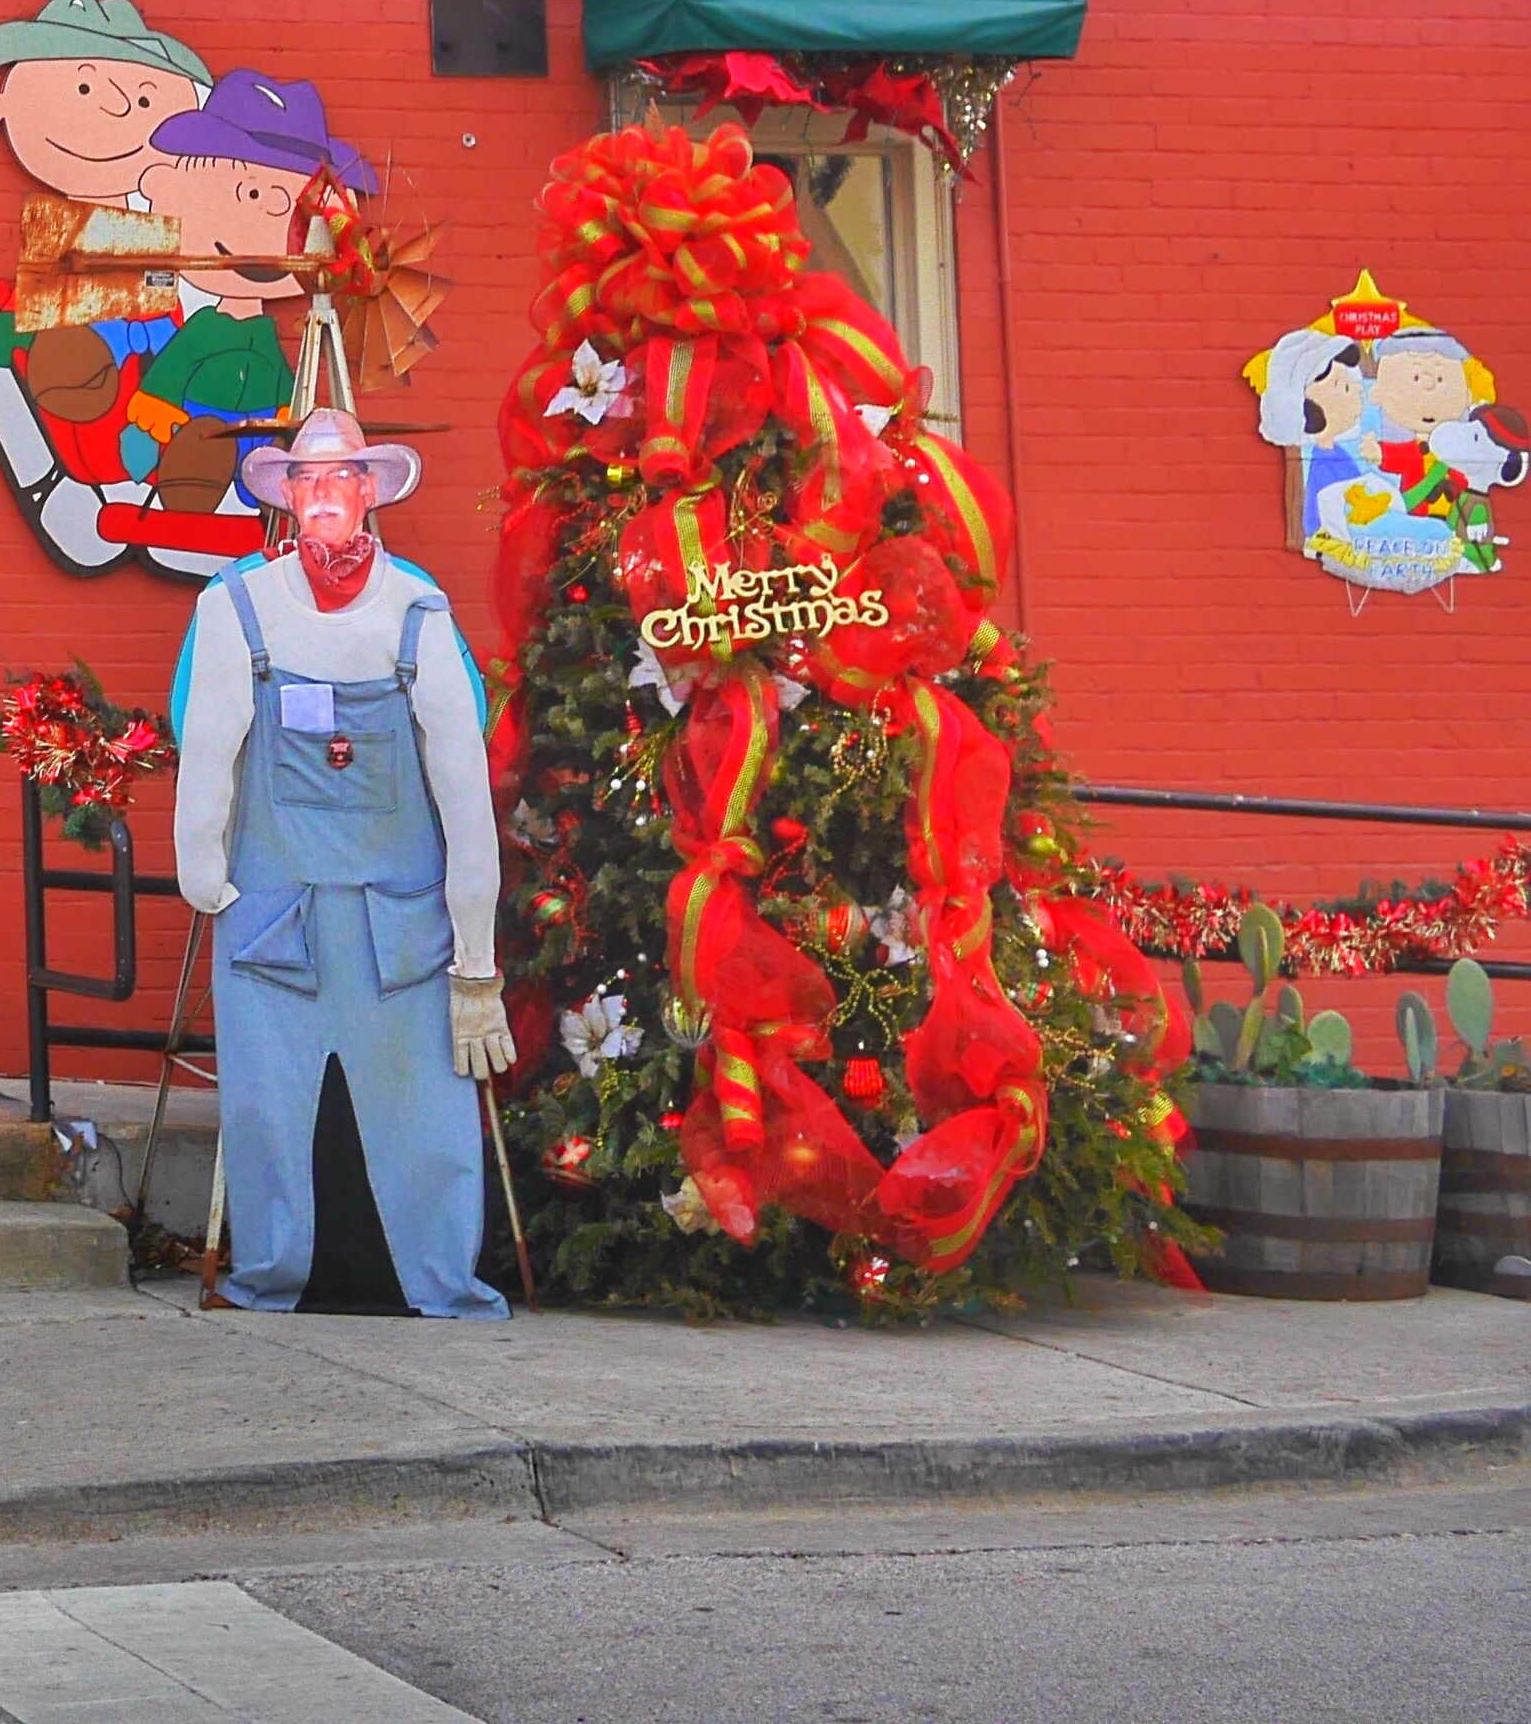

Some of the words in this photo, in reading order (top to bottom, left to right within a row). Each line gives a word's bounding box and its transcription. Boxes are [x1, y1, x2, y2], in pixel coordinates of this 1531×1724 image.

[1339, 311, 1398, 323] CHRISTMAS
[1355, 324, 1380, 336] PLAY
[1354, 537, 1413, 556] PEACE
[687, 553, 838, 604] Merry
[640, 588, 889, 650] Christmas
